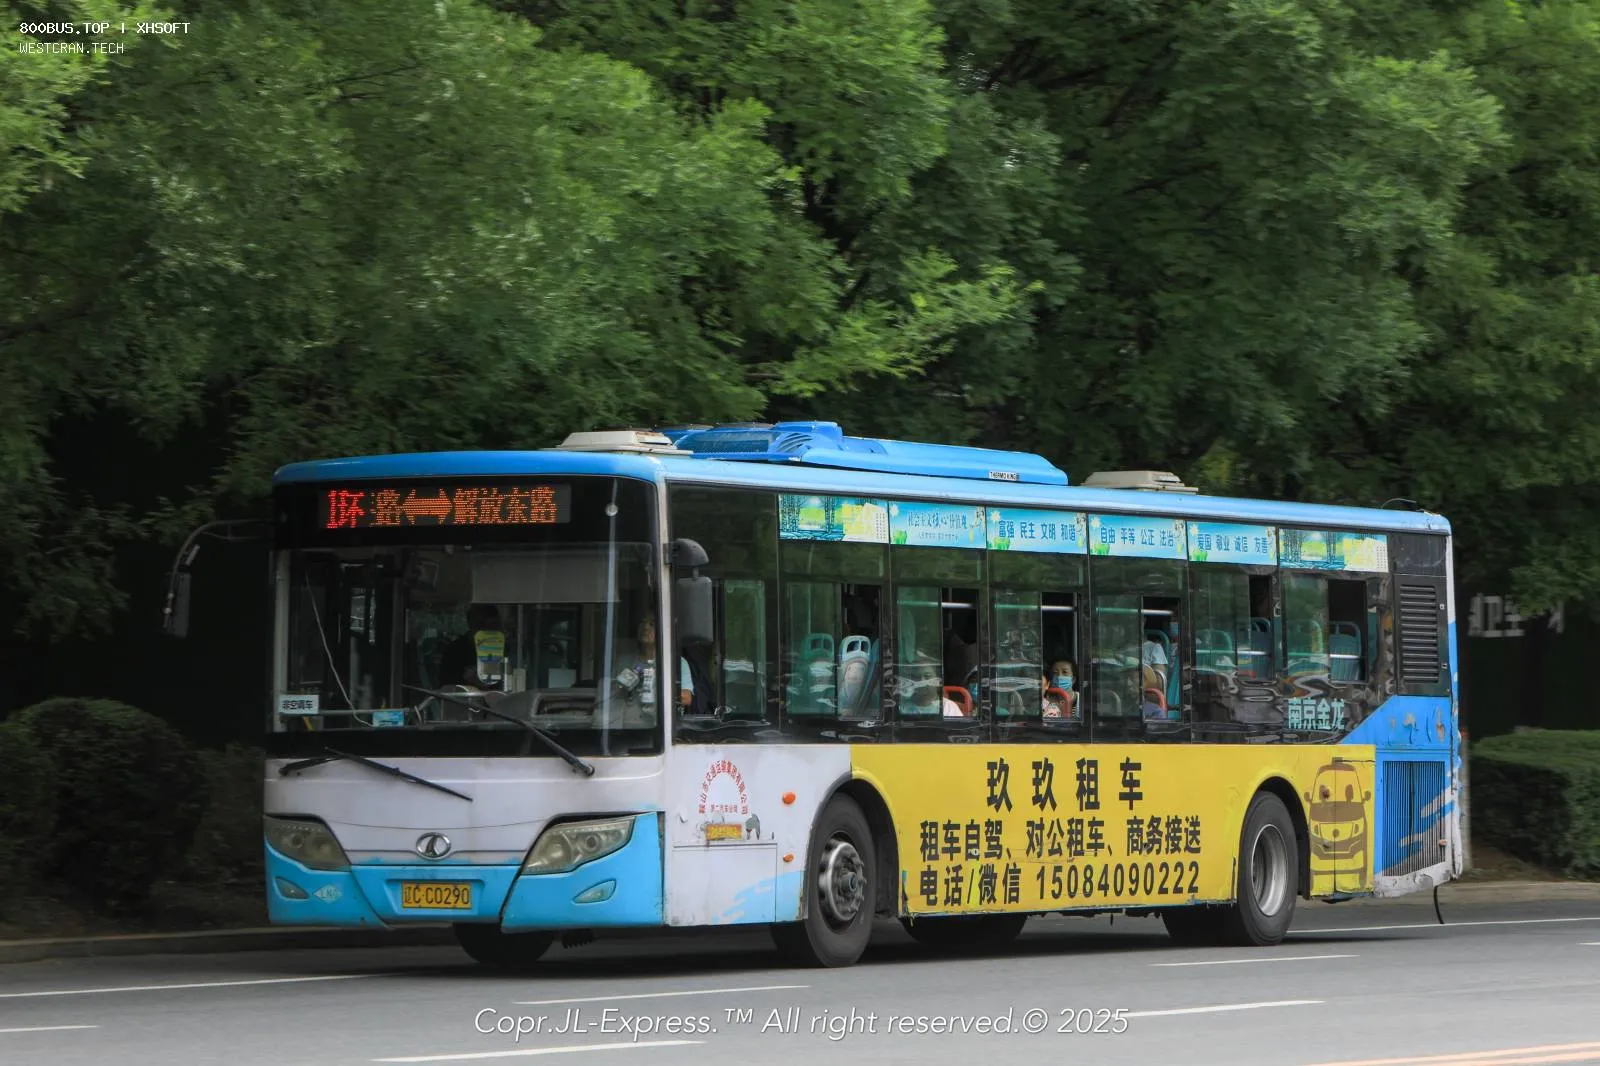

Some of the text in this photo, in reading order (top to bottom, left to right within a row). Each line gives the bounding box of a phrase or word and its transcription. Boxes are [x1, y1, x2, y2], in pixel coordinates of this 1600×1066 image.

[453, 486, 558, 525] 解放东路
[999, 520, 1076, 541] 富强 民主 文明 和谐
[1100, 527, 1174, 547] 自由 平等 公正 法治
[1198, 533, 1268, 554] 爱国 敬业 诚信 友善
[1287, 697, 1345, 730] 南京金龙
[986, 756, 1143, 813] 玖玖租车
[919, 860, 1199, 907] 电话/微信 15084090222
